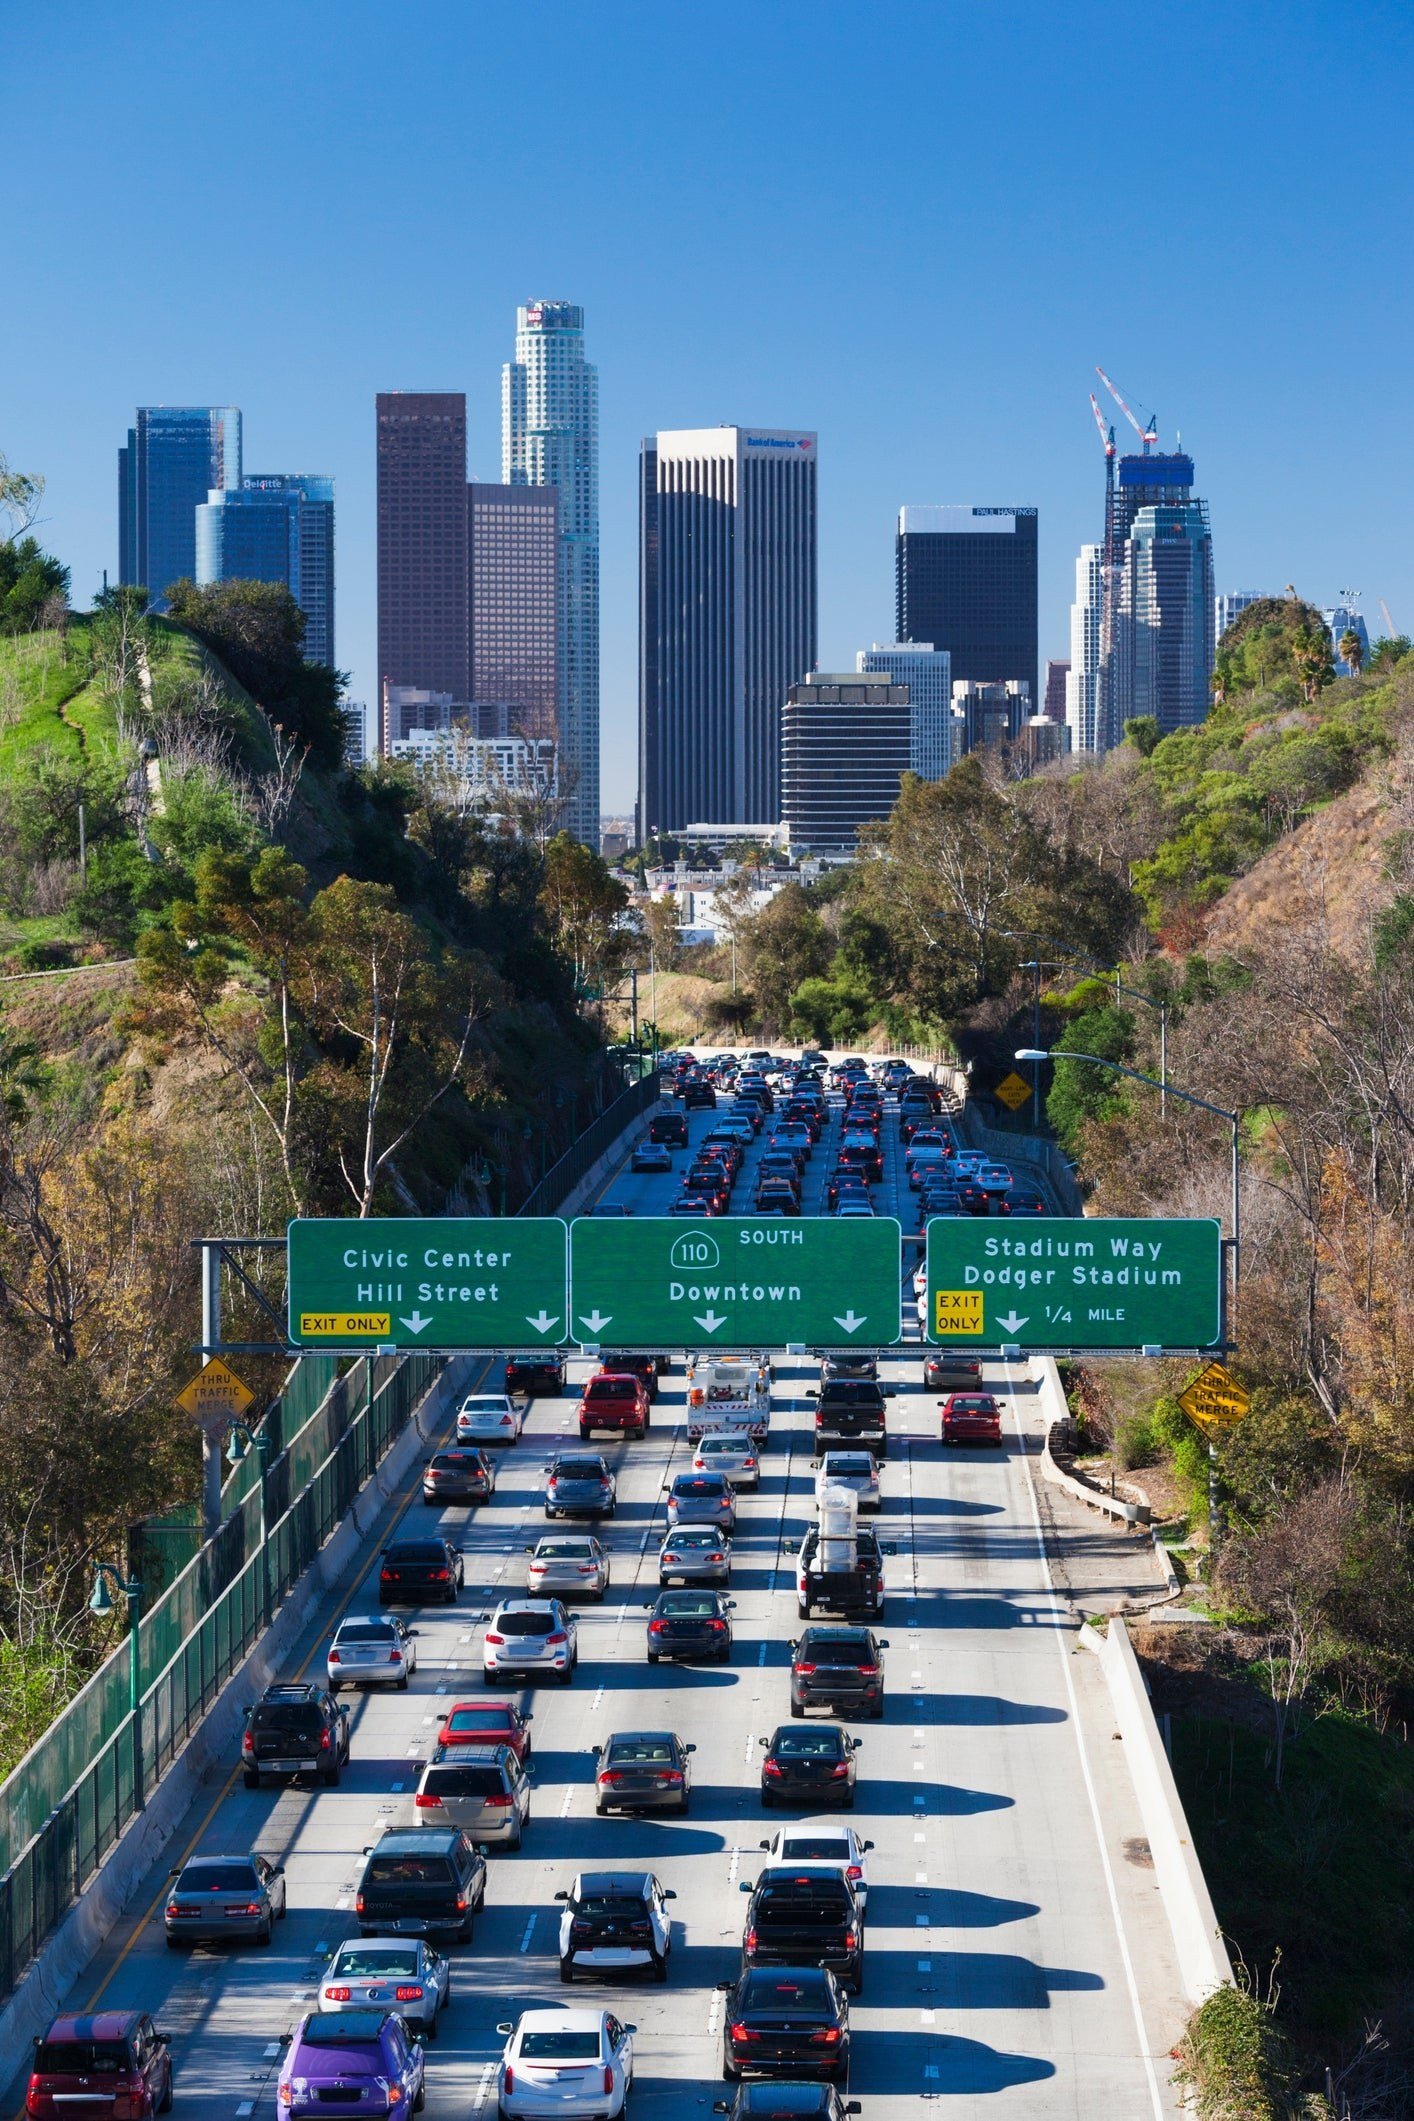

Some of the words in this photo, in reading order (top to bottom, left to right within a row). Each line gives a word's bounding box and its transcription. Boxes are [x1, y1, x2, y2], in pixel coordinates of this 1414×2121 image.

[998, 508, 1036, 516] HASTINGS
[740, 1230, 803, 1244] SOUTH
[682, 1244, 708, 1261] 110
[984, 1237, 1094, 1257] Stadium
[1110, 1238, 1162, 1261] Way
[343, 1249, 408, 1268] Civic
[424, 1249, 512, 1268] Center
[964, 1265, 1056, 1290] Dodger
[1072, 1266, 1181, 1285] Stadium
[357, 1283, 402, 1302] Hill
[417, 1283, 499, 1302] Street
[670, 1282, 801, 1301] Downtown
[940, 1295, 980, 1308] EXIT
[1088, 1308, 1125, 1321] MILE
[303, 1318, 337, 1331] EXIT
[346, 1318, 387, 1331] ONLY
[938, 1317, 980, 1330] ONLY
[201, 1374, 230, 1384] THRU
[1203, 1377, 1230, 1387] THRU
[193, 1387, 239, 1397] TRAFFIC
[1193, 1391, 1240, 1401] TRAFFIC
[197, 1399, 234, 1410] MERGE
[1195, 1404, 1239, 1415] MERGE
